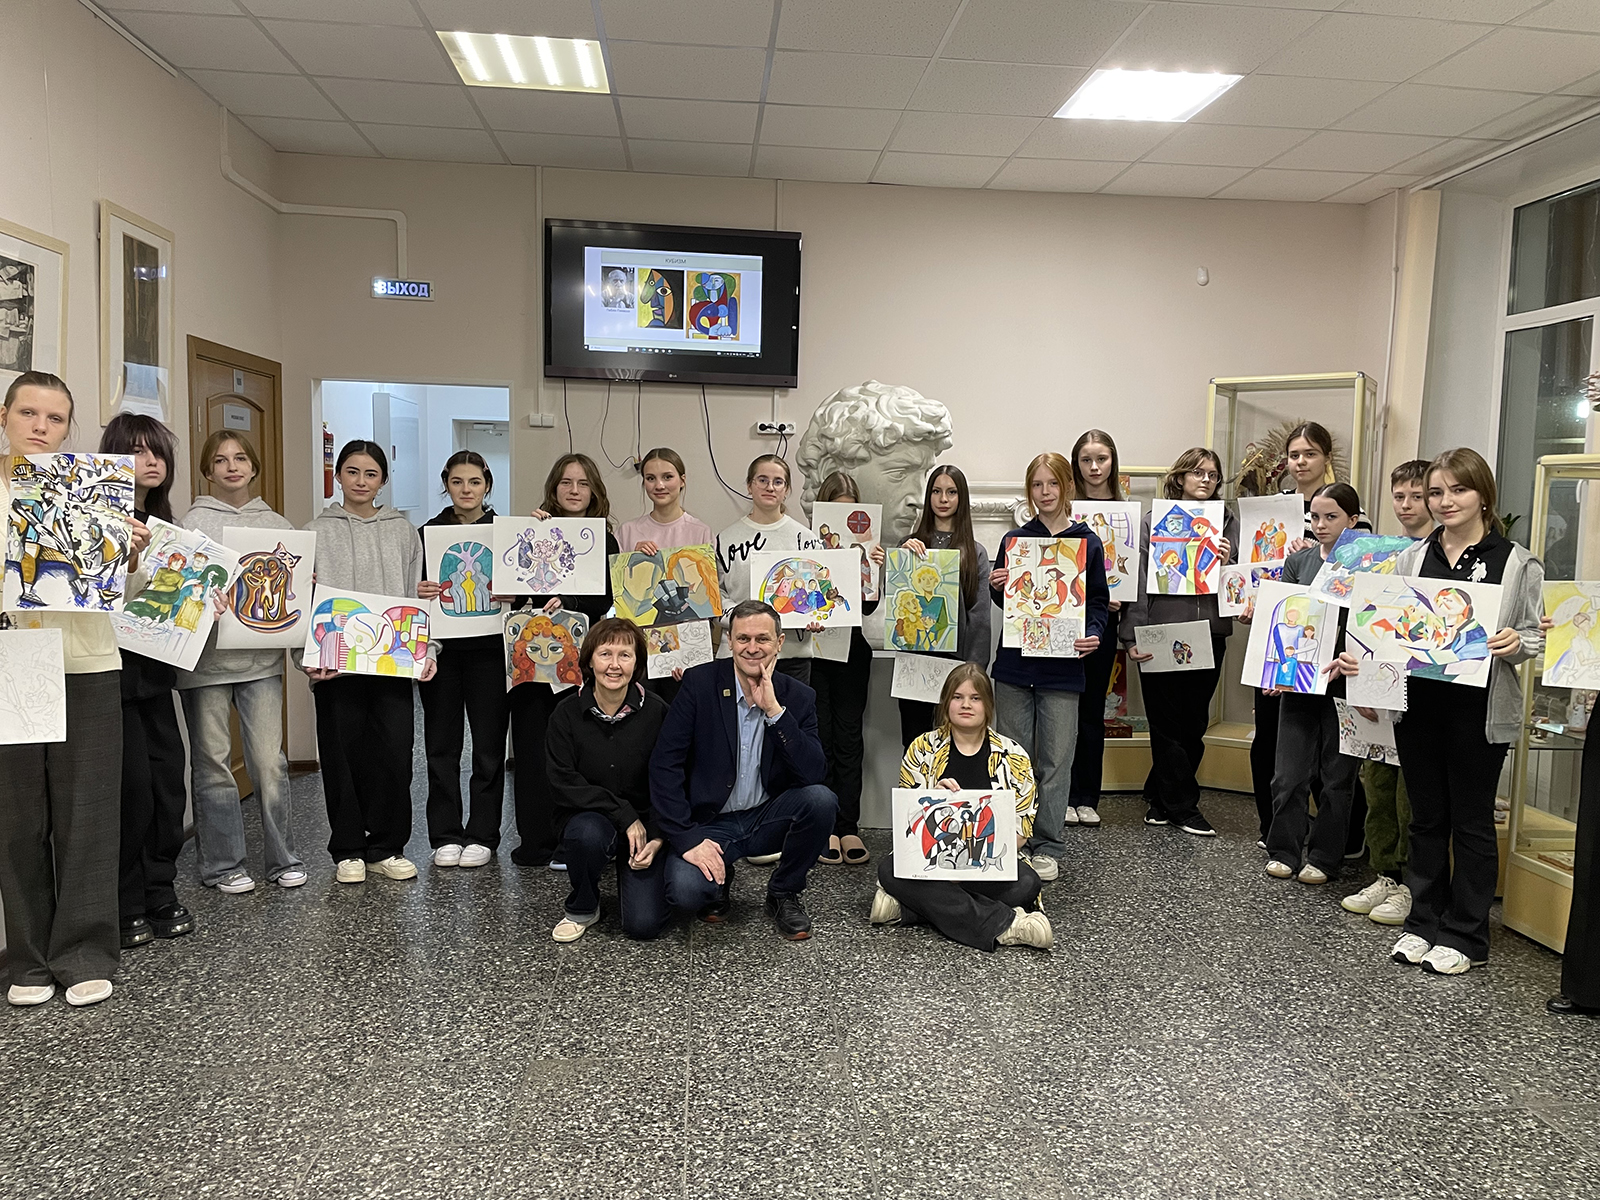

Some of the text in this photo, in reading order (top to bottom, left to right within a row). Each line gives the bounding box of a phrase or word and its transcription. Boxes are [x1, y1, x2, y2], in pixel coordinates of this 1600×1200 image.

[377, 281, 429, 297] ВЫХОД
[797, 531, 823, 551] lov
[716, 532, 767, 574] love
